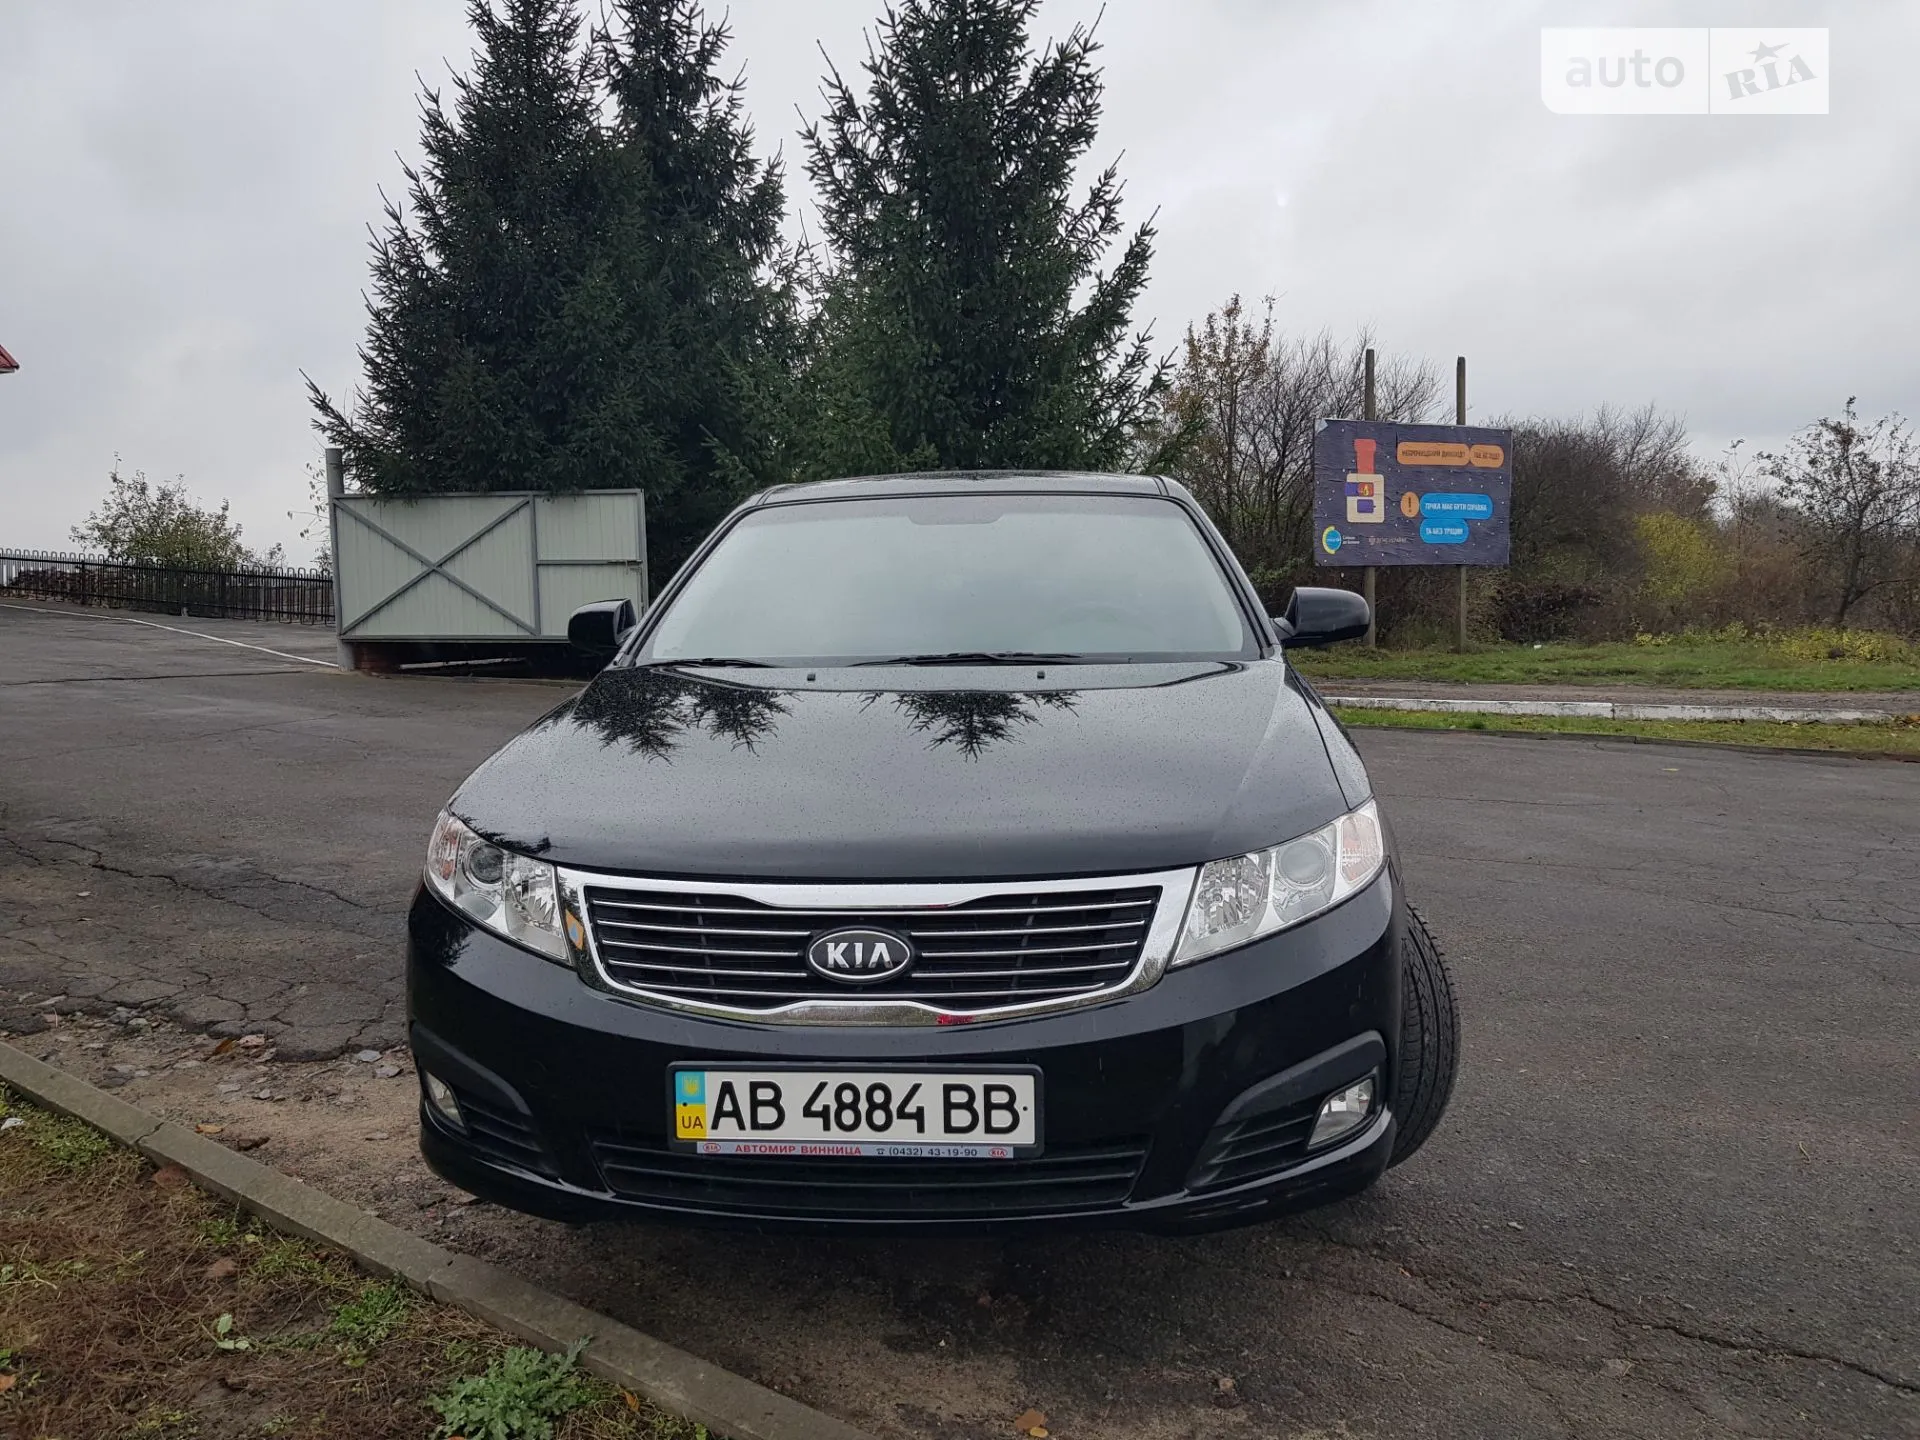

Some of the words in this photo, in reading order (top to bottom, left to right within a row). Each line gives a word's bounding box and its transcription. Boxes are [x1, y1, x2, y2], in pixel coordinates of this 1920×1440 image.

[826, 942, 894, 969] KIA
[711, 1080, 786, 1132] AB
[802, 1081, 926, 1134] 4884
[942, 1083, 1020, 1135] BB
[681, 1115, 704, 1131] UA
[734, 1144, 796, 1155] АВТОМИР
[800, 1145, 862, 1156] ВИННИЦА
[888, 1146, 923, 1157] (0432)
[927, 1147, 978, 1157] 43-19-90
